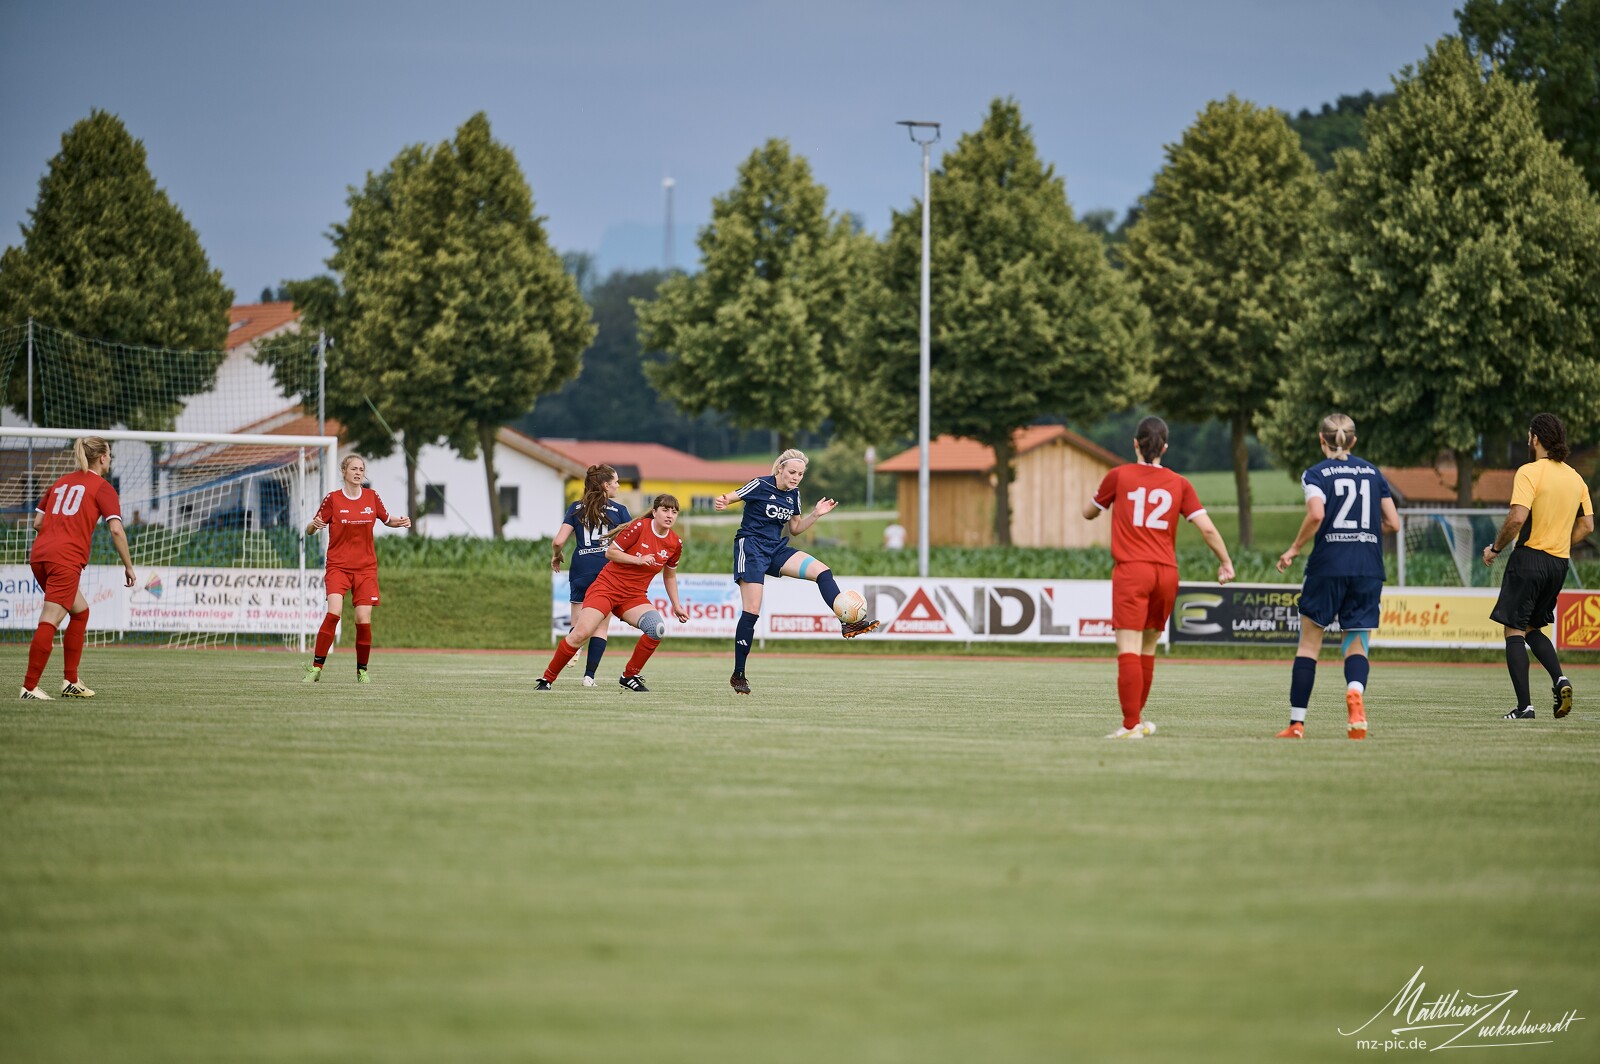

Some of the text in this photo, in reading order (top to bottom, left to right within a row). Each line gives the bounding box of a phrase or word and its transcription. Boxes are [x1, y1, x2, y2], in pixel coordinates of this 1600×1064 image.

[52, 484, 86, 516] 10
[1127, 487, 1173, 530] 12
[1333, 478, 1370, 529] 21
[176, 574, 325, 589] AUTOLACKIERR
[195, 592, 242, 606] Rolke
[248, 593, 260, 607] &
[1232, 592, 1302, 606] FAHRSC
[864, 585, 1071, 635] DANDL
[1244, 606, 1301, 621] NGEL
[1382, 602, 1450, 628] music
[1232, 618, 1277, 631] LAUFEN
